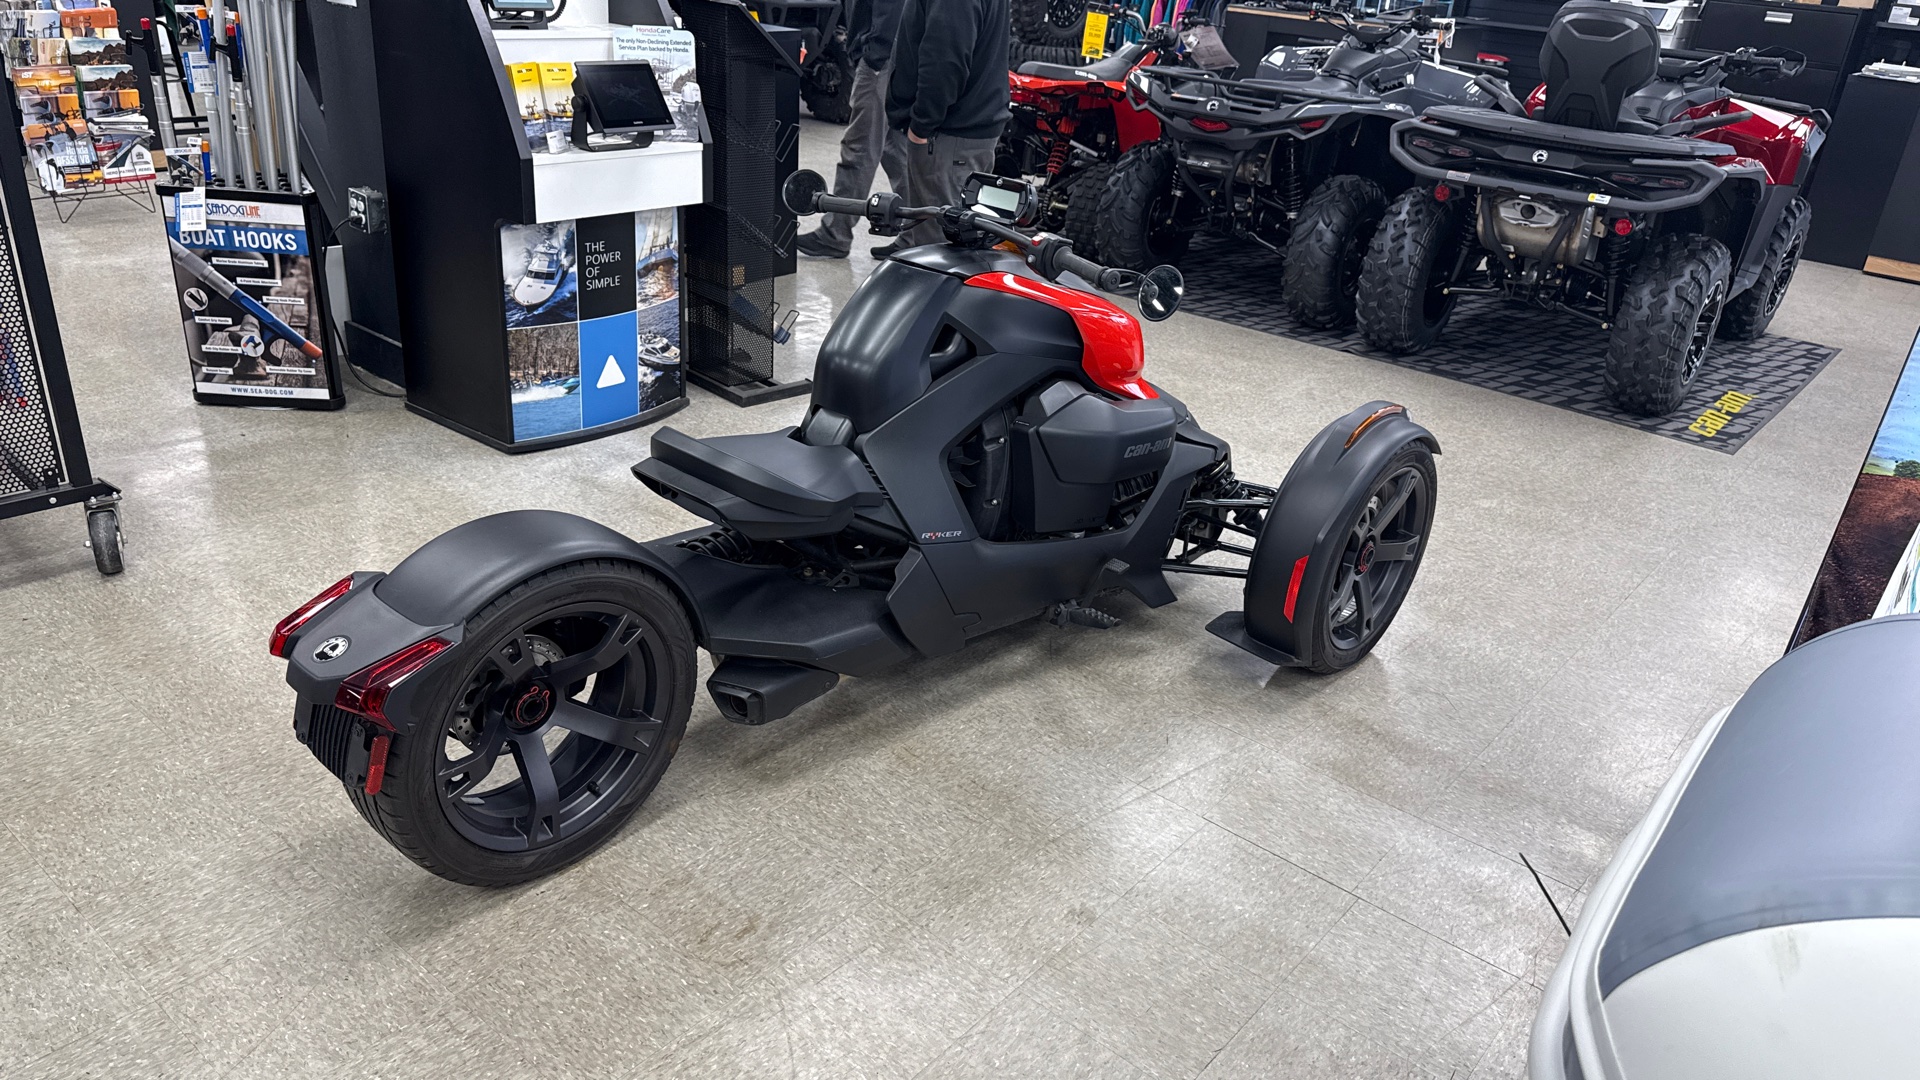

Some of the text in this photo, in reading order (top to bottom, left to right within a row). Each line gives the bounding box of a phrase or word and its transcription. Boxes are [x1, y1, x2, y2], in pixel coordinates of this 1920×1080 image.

[636, 38, 669, 46] Non-Declining
[233, 230, 298, 251] HOOKS
[584, 241, 606, 253] THE
[585, 251, 621, 266] POWER
[585, 266, 600, 278] OF
[586, 275, 621, 290] SIMPLE
[231, 386, 294, 396] WWW.SEA-DOG.COM
[1688, 391, 1754, 437] can-am
[1123, 436, 1172, 459] can-am
[921, 530, 962, 540] RYKER
